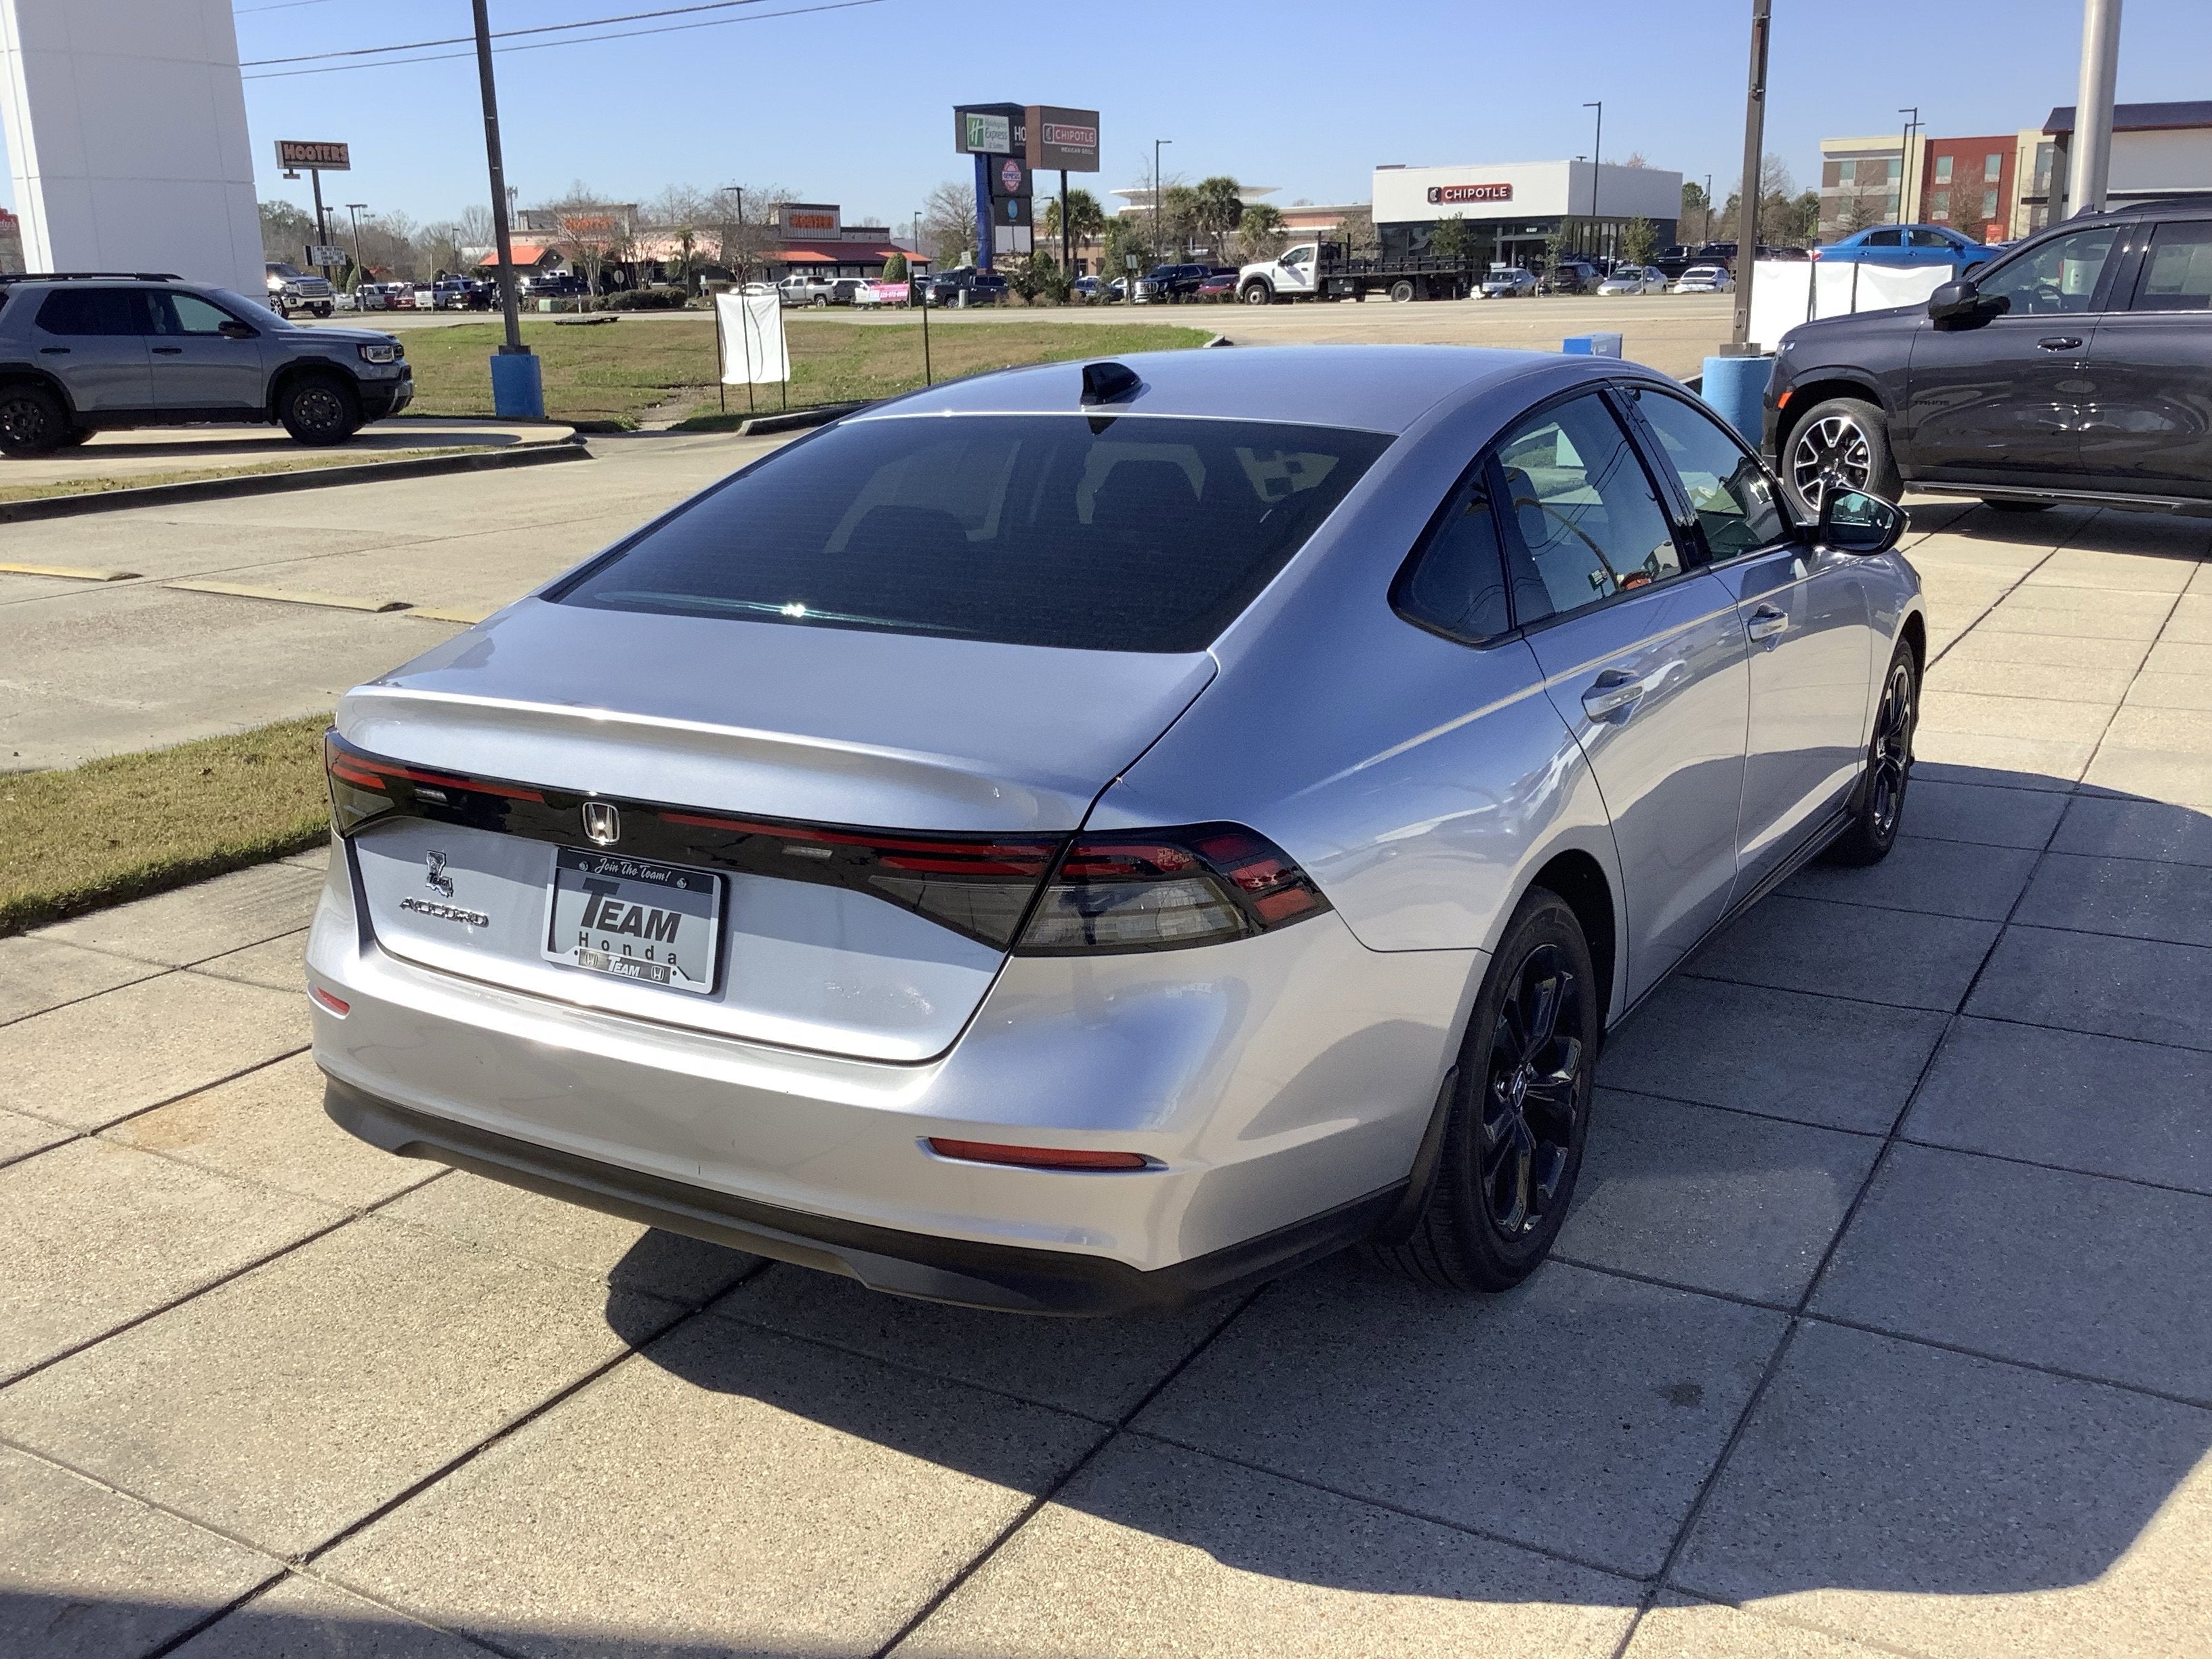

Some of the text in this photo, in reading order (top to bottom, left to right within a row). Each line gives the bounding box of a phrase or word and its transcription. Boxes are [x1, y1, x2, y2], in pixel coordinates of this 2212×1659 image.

[1055, 129, 1094, 142] CHIPOTLE
[283, 144, 348, 162] HOOTERS
[1445, 186, 1507, 199] CHIPOTLE
[594, 858, 672, 882] Join The Team!
[399, 897, 489, 928] ACCORD
[581, 877, 682, 944] TEAM
[579, 931, 677, 966] Honda
[608, 956, 640, 977] TEAM
